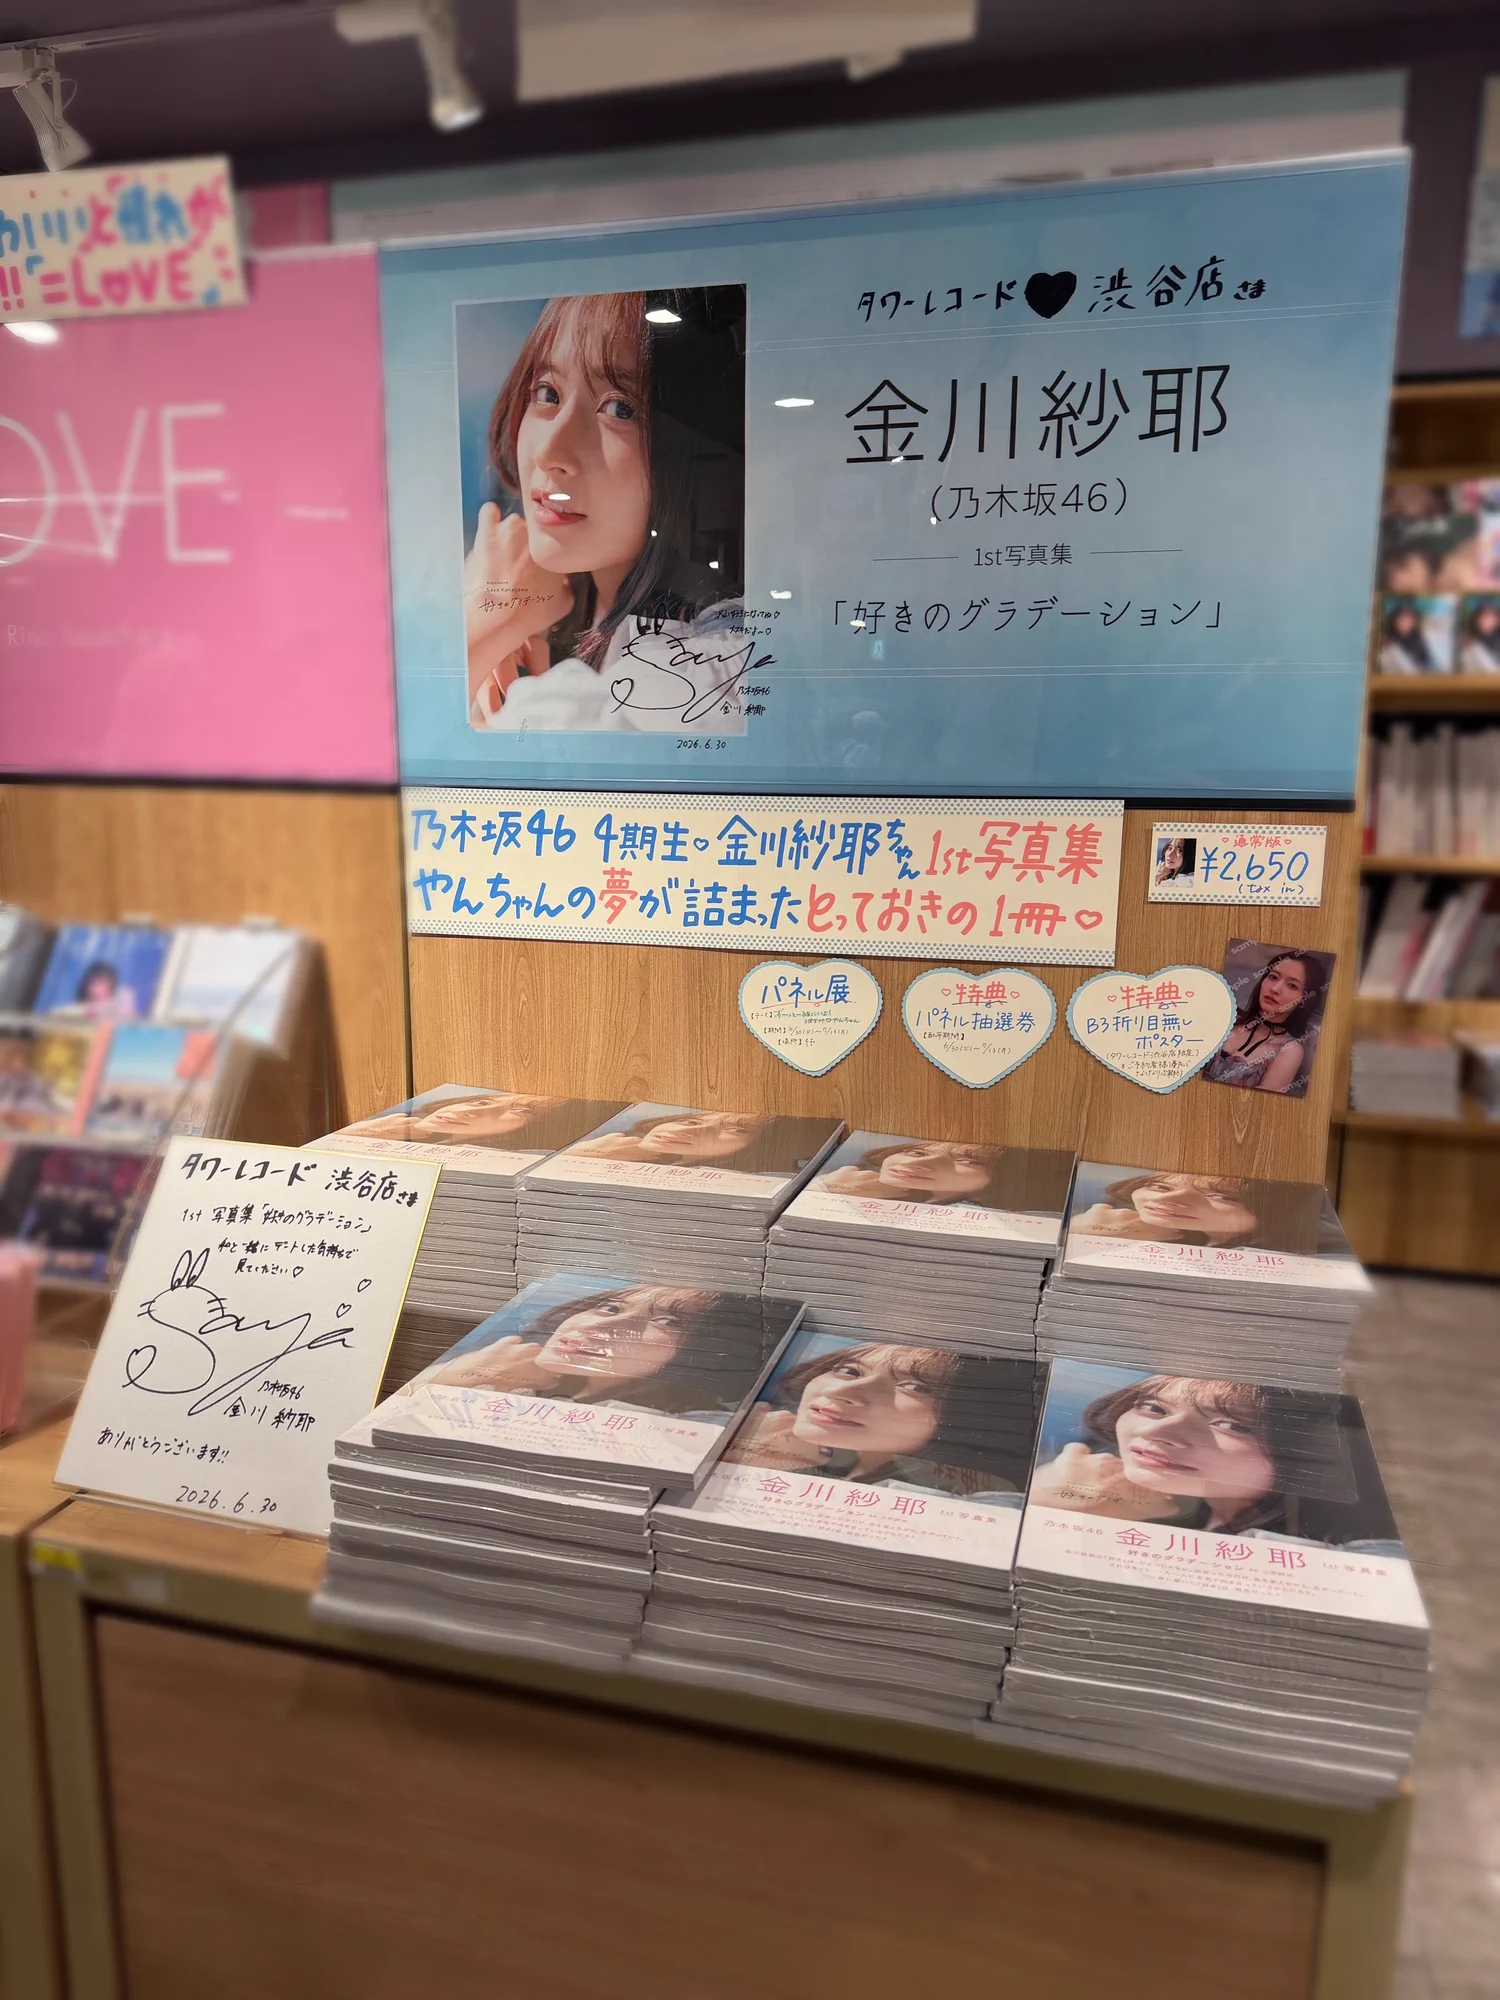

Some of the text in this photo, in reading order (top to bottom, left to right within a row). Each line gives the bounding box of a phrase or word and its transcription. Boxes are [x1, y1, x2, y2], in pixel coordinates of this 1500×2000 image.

[857, 280, 1018, 323] タワーレコード
[845, 364, 1231, 465] 金川紗耶
[931, 477, 1127, 523] （乃木坂46）
[973, 543, 1073, 567] 1st写真集
[832, 594, 1222, 635] 「好きのグラデーション」
[411, 809, 577, 857] 乃木坂46
[593, 813, 690, 863] 4期生
[1232, 835, 1282, 848] 通常版
[1200, 846, 1310, 883] ¥2,650
[761, 974, 850, 1008] パネル展
[955, 981, 1008, 1006] 特典
[1120, 981, 1182, 1010] 特典
[916, 1007, 1036, 1033] パネル抽選券
[1086, 1012, 1193, 1035] B3折り目無し
[1135, 1033, 1204, 1050] ポスター
[181, 1152, 318, 1188] タワーレコード
[1139, 1243, 1285, 1266] 金川紗耶
[480, 1397, 638, 1431] 金川紗耶
[756, 1476, 928, 1516] 金川紗耶
[1115, 1527, 1307, 1570] 金川紗耶
